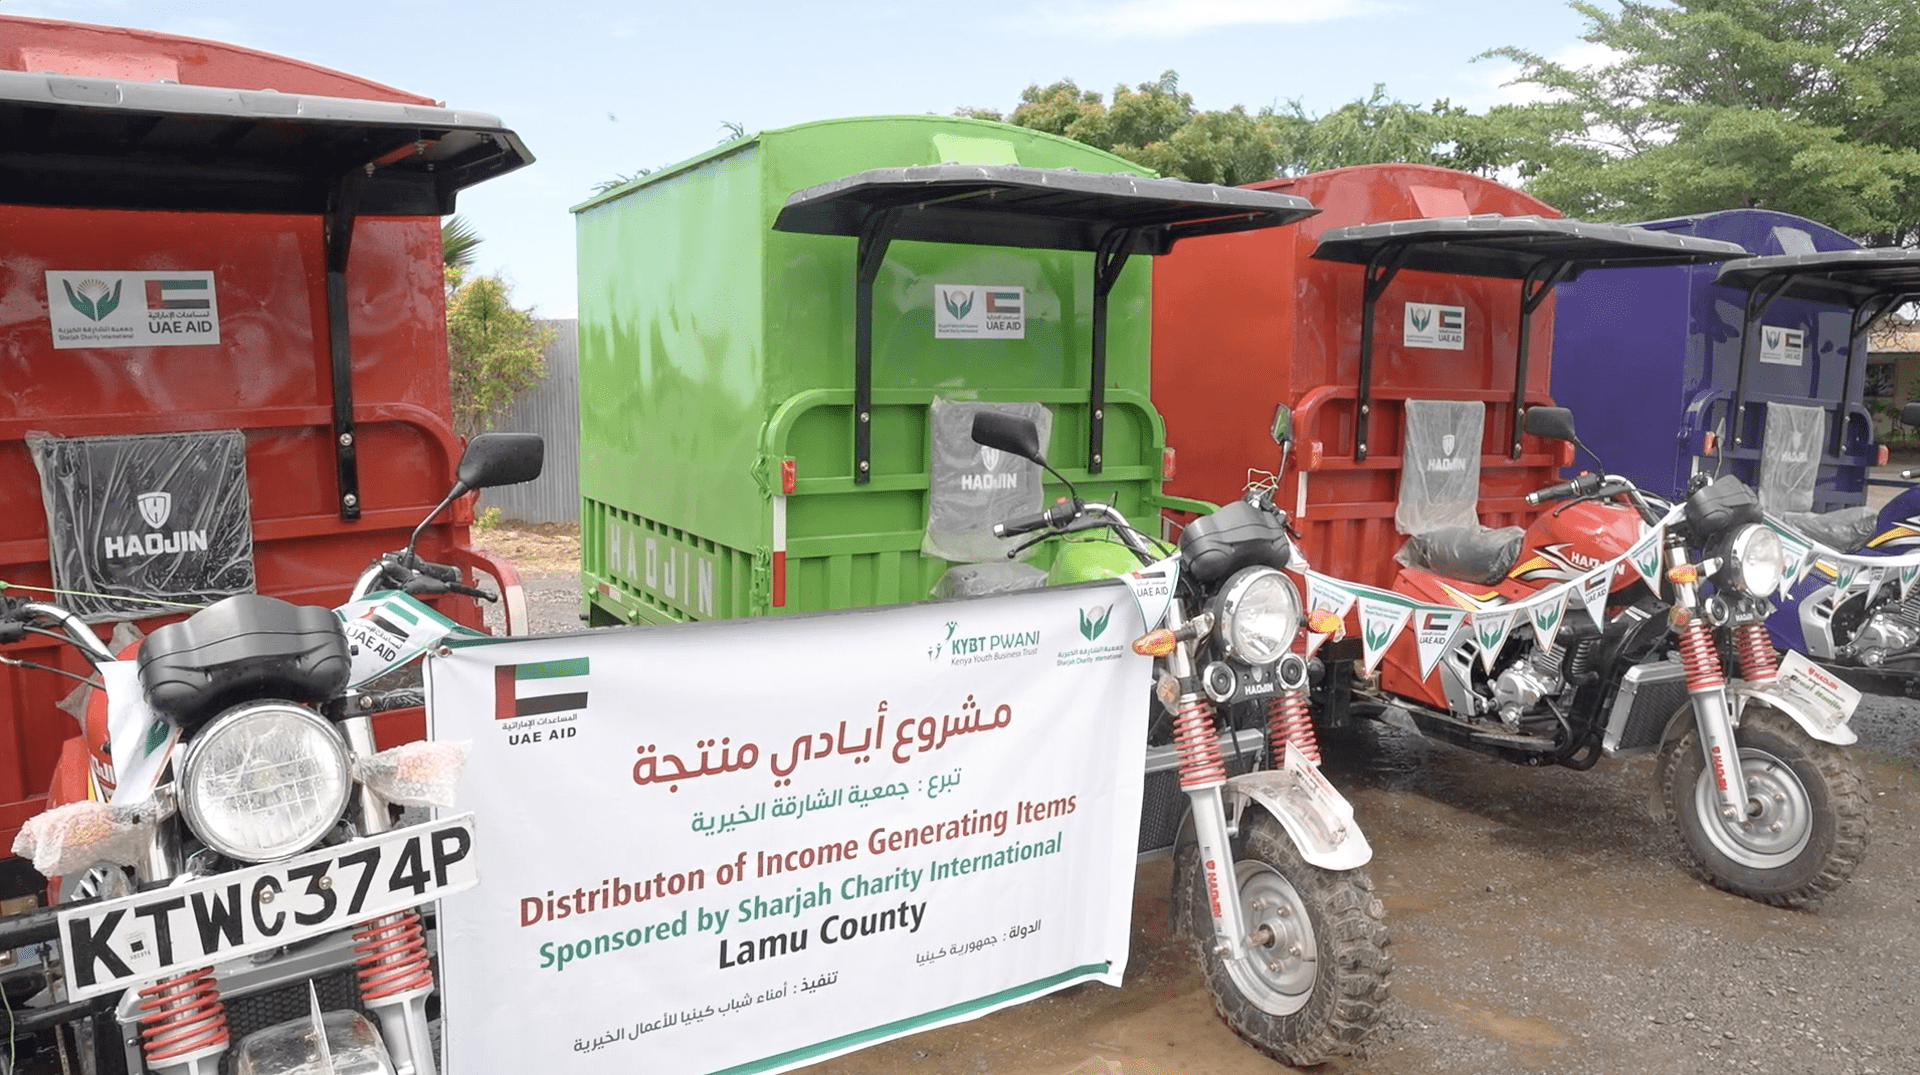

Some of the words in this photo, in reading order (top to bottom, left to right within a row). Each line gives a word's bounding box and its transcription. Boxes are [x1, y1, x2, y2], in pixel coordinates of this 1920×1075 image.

[148, 321, 183, 334] UAE
[186, 320, 213, 333] AID
[986, 321, 1004, 330] UAE
[1006, 321, 1022, 330] AID
[962, 472, 1017, 490] HAOJIN
[104, 529, 208, 559] HAOJIN
[611, 524, 713, 618] HAOJIN
[1571, 551, 1626, 575] HAON
[1137, 587, 1153, 597] UAE
[1155, 586, 1168, 595] AID
[346, 626, 376, 649] UAE
[373, 644, 396, 662] AID
[952, 636, 986, 655] KYBT
[990, 630, 1040, 651] PWANI
[1420, 636, 1433, 644] UAE
[951, 657, 972, 667] Kenya
[973, 654, 993, 663] Youth
[994, 650, 1021, 661] Business
[1022, 648, 1038, 656] Trust
[509, 731, 542, 746] UAE
[549, 727, 577, 741] AID
[892, 694, 1012, 764] مشروع
[770, 700, 888, 787] أيادي
[633, 737, 759, 793] منتجة
[848, 780, 909, 808] جمعية
[927, 767, 962, 798] تبرع
[771, 788, 843, 820] الشارقة
[691, 802, 765, 837] الخيرية
[520, 867, 705, 927] Distributon
[716, 852, 747, 885] of
[757, 840, 858, 878] Income
[868, 808, 1008, 856] Generating
[1016, 794, 1076, 825] Items
[539, 910, 687, 972] Sponsored
[697, 907, 730, 934] by
[738, 882, 832, 922] Sharjah
[841, 866, 923, 900] Charity
[930, 831, 1062, 883] International
[719, 929, 808, 969] Lamu
[820, 901, 927, 944] County
[1009, 919, 1042, 939] الدولة
[916, 947, 947, 967] كينيا
[949, 935, 998, 956] جمهورية
[756, 982, 787, 1004] أمناء
[800, 971, 839, 994] تنفيذ
[680, 1005, 715, 1024] كينيا
[718, 993, 753, 1016] شباب
[628, 1012, 678, 1041] للأعمال
[573, 1027, 625, 1054] الخيرية
